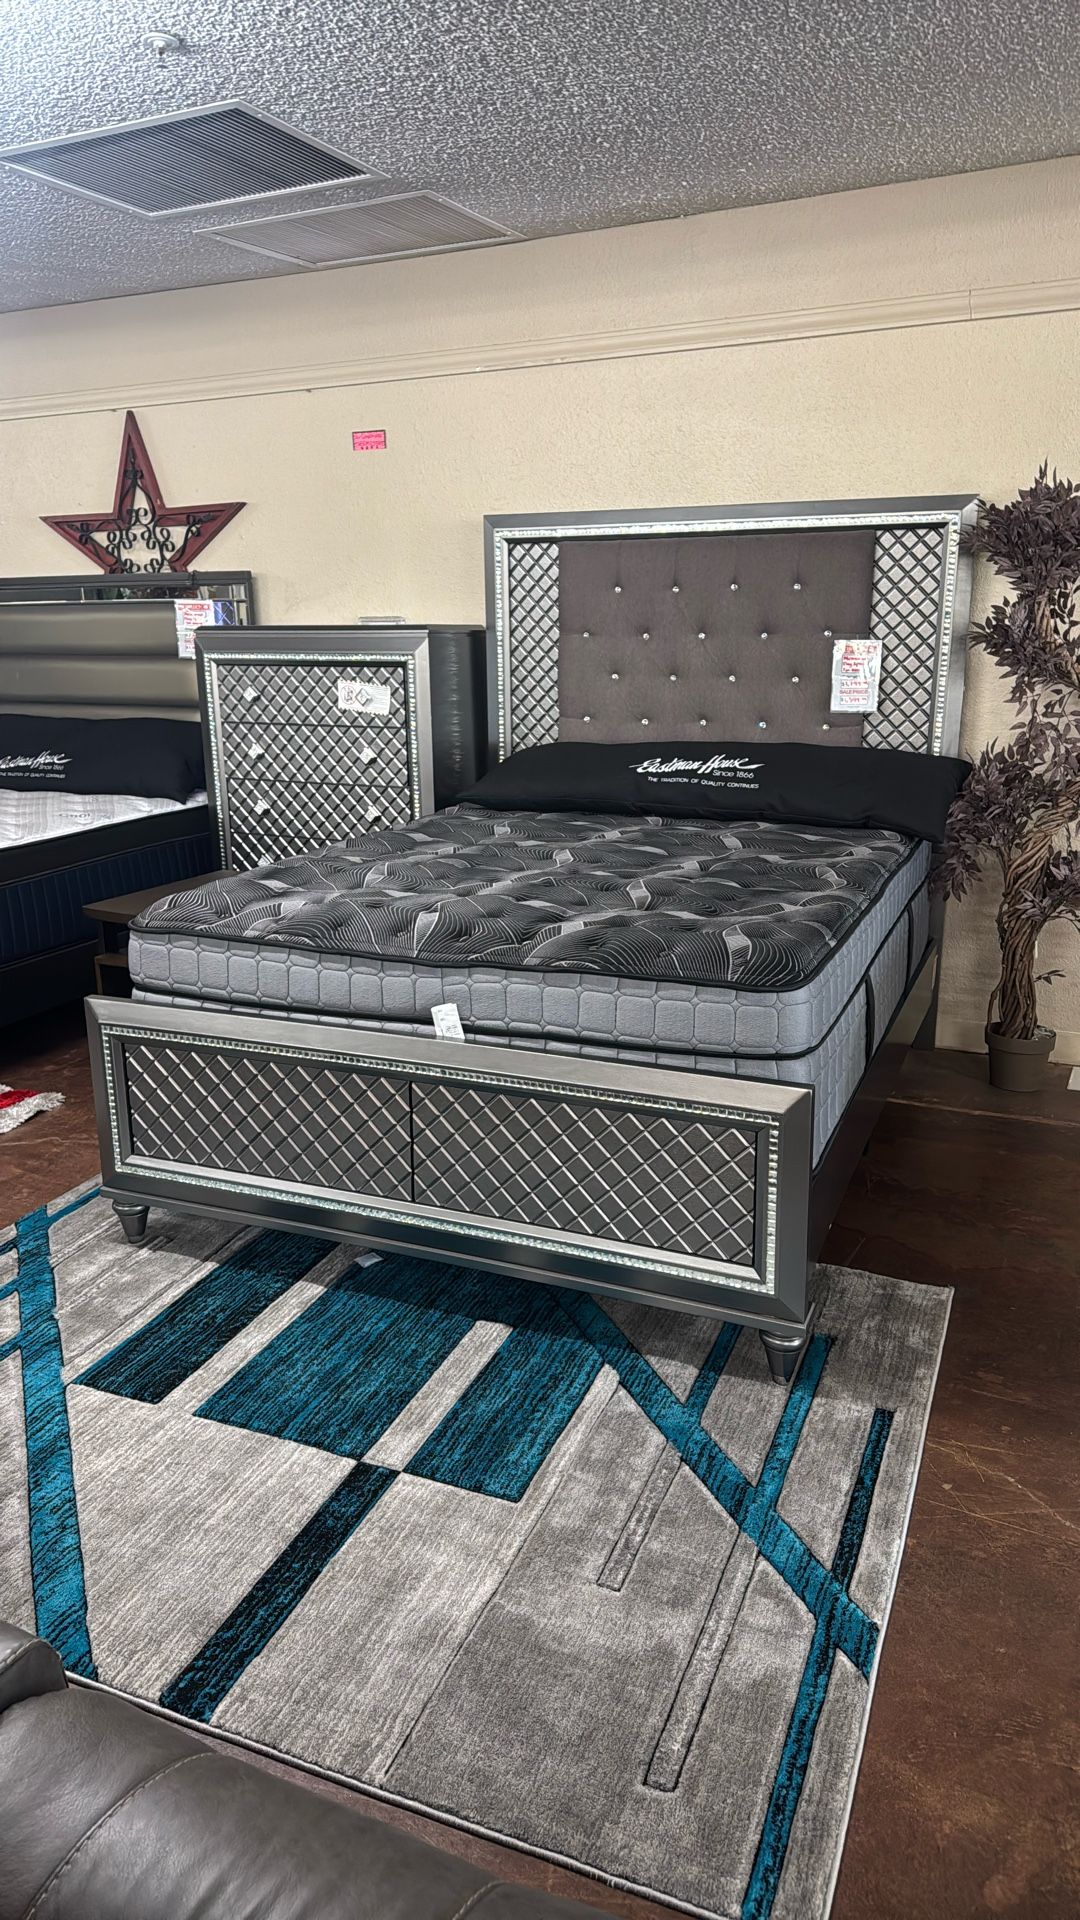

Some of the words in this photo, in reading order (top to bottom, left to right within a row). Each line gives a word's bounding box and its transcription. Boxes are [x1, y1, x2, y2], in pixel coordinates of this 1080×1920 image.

[628, 757, 702, 773] Eastman
[697, 753, 766, 774] House
[712, 769, 735, 777] Since
[736, 770, 755, 779] 1866
[701, 779, 725, 787] QUALITY
